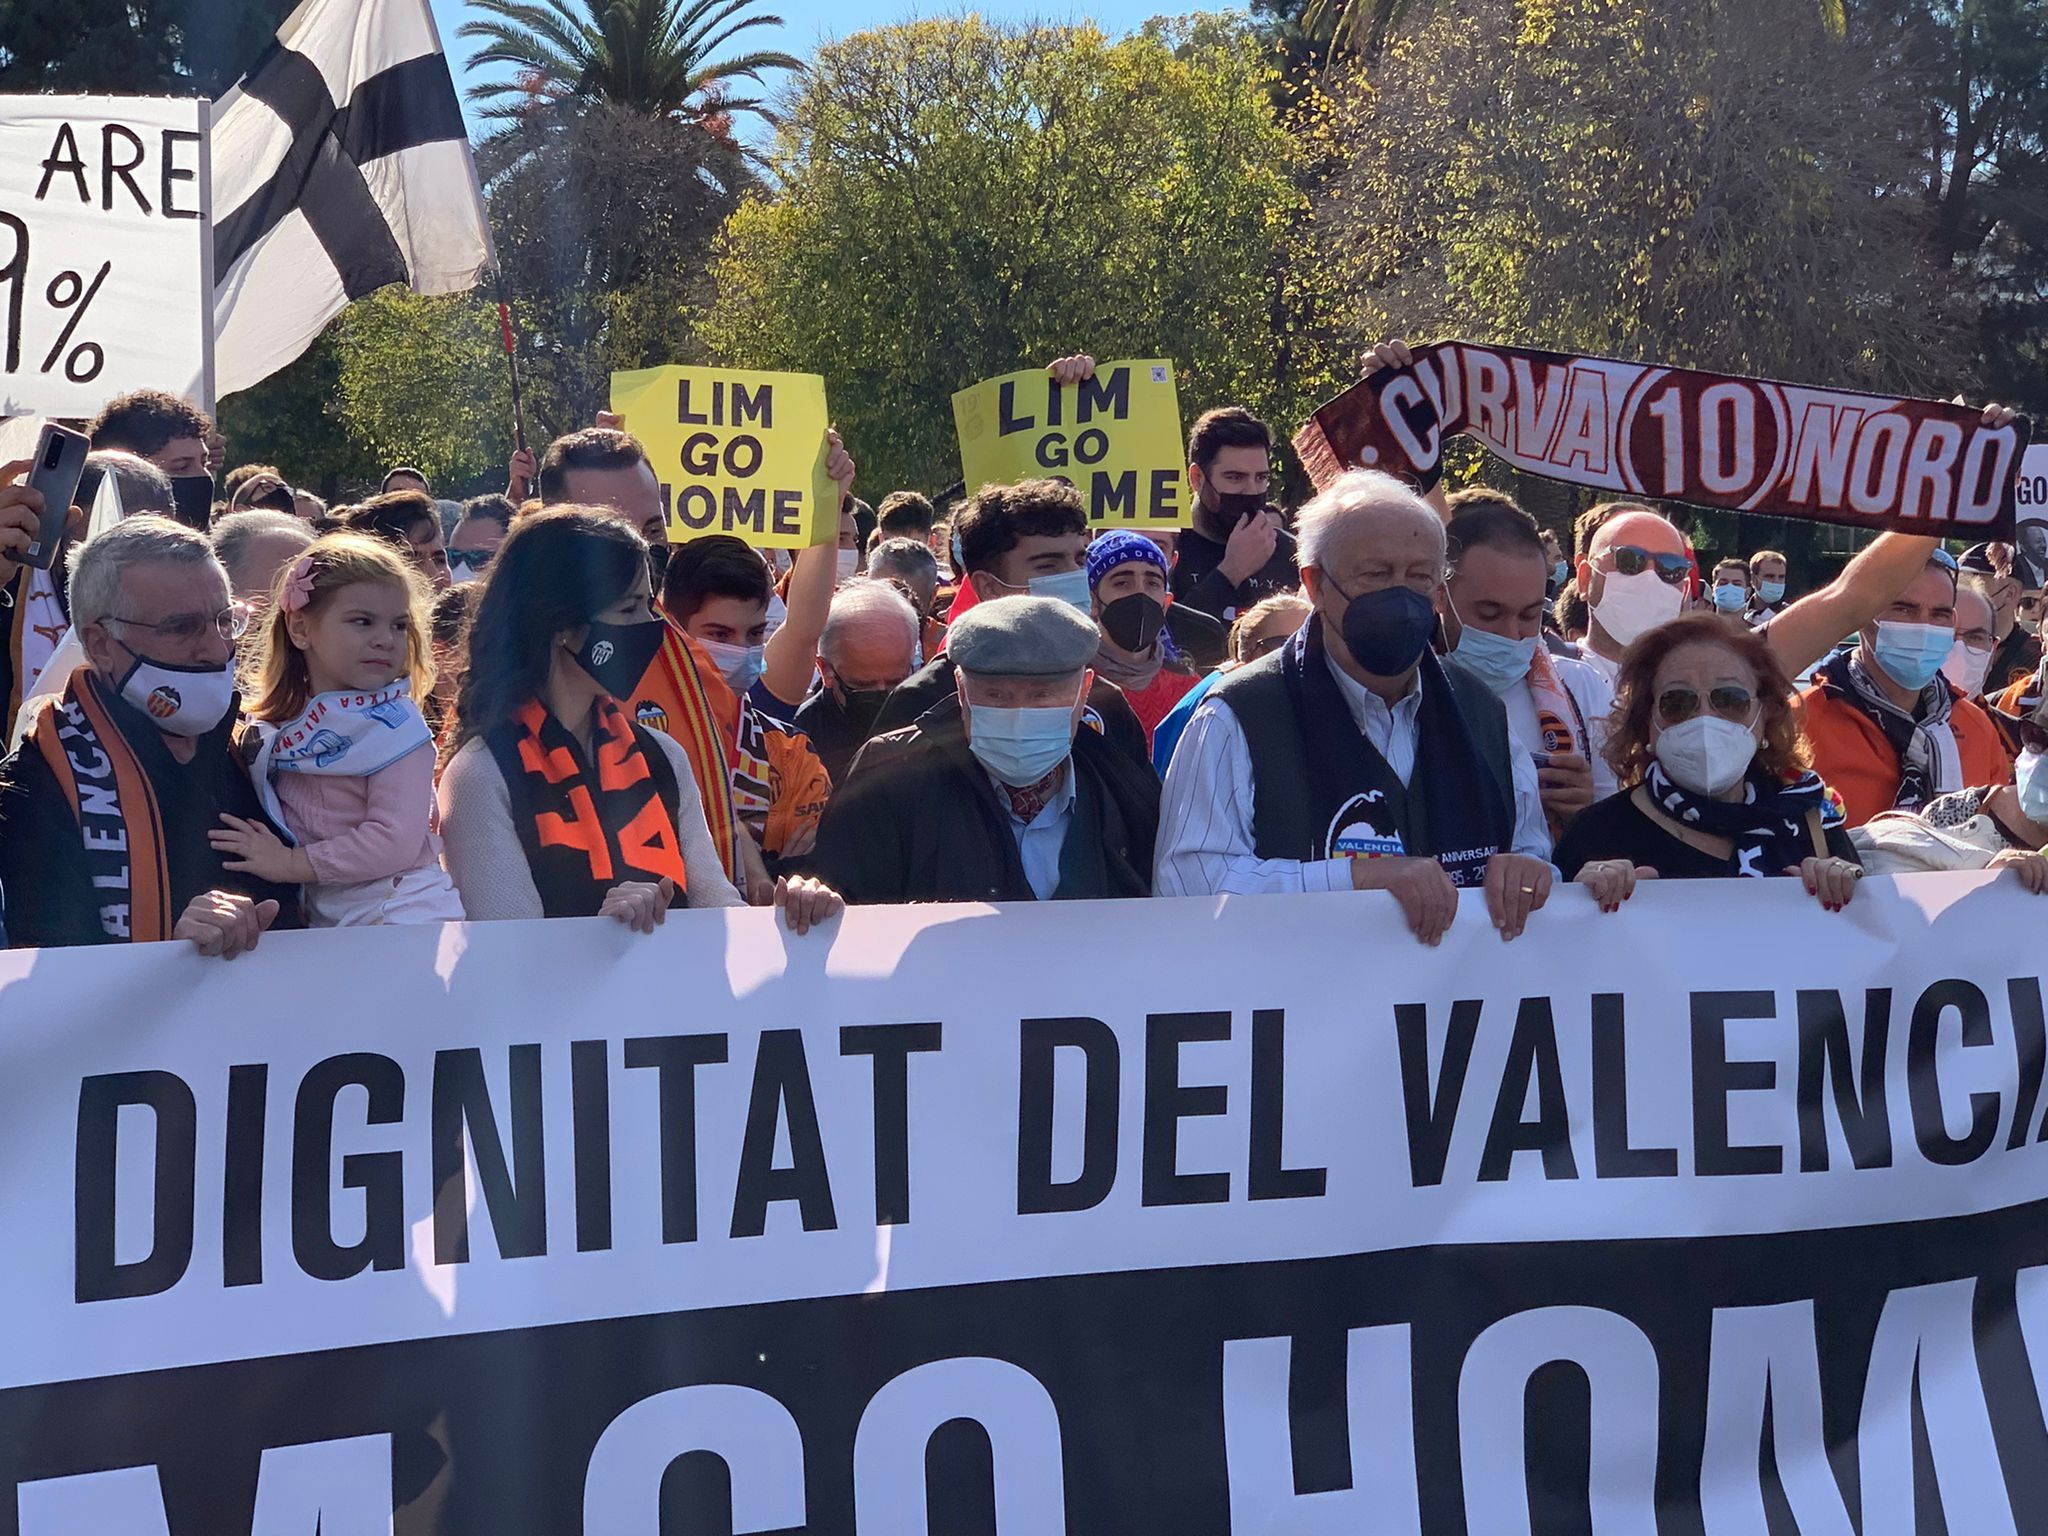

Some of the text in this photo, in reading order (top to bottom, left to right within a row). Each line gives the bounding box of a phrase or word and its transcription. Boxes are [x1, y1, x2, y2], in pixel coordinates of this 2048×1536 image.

[35, 122, 206, 219] ARE
[678, 379, 773, 429] LIM
[999, 367, 1131, 437] LIM
[680, 432, 763, 479] GO
[1035, 428, 1109, 469] GO
[1379, 346, 1609, 475] CURVA
[1788, 402, 2018, 524] NORD
[1337, 840, 1404, 854] VALENCIA
[74, 976, 2048, 1304] DIGNITAT DEL VALENCI
